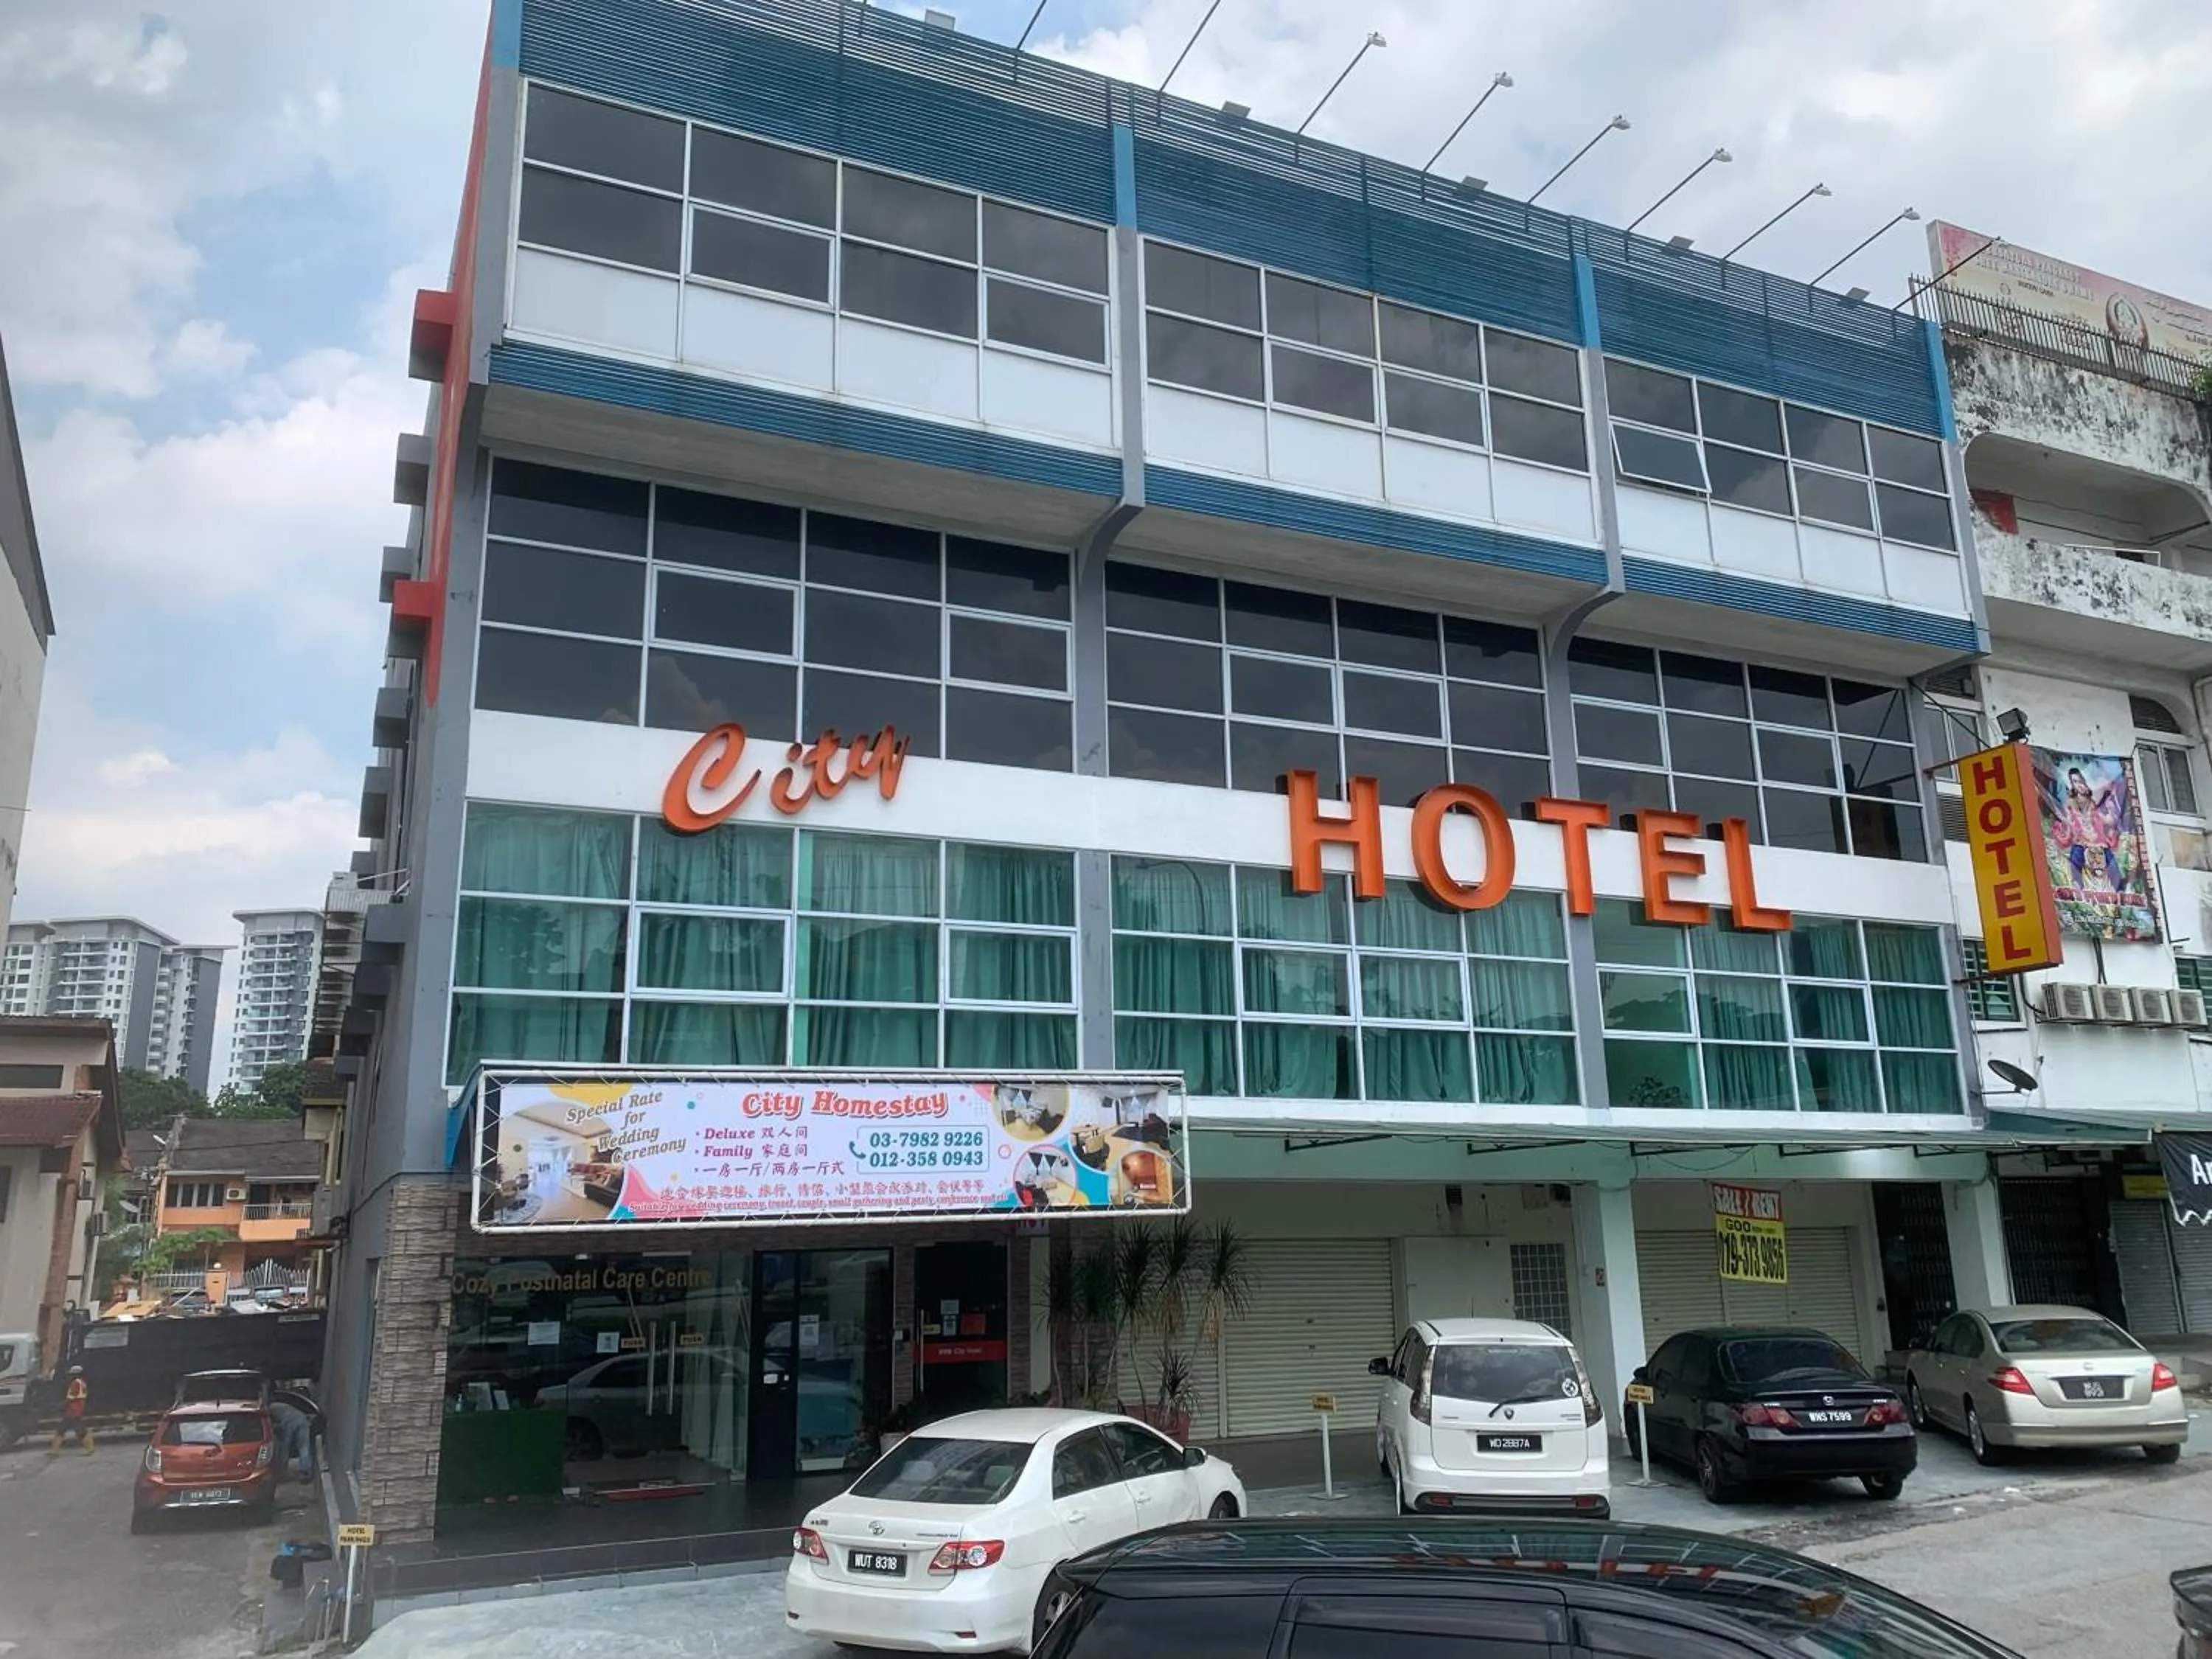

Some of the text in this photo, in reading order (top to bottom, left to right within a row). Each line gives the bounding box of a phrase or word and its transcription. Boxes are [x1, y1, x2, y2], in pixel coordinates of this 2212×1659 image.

[661, 722, 911, 833] City
[1287, 768, 1792, 931] HOTEL
[1972, 756, 2032, 960] HOTEL
[566, 1091, 663, 1124] Special Rate
[742, 1089, 949, 1119] City Homestay
[621, 1110, 646, 1130] for
[704, 1126, 808, 1139] Deluxe 双人间
[598, 1125, 660, 1152] Wedding
[611, 1136, 687, 1164] Ceremony
[703, 1143, 808, 1159] Family 家庭间
[869, 1131, 984, 1147] 03-7982 9226
[869, 1150, 984, 1167] 012-358 0943
[452, 1272, 498, 1297] Cozy
[602, 1266, 645, 1288] Care
[651, 1265, 712, 1287] Centre
[855, 1554, 897, 1571] WUT 8318
